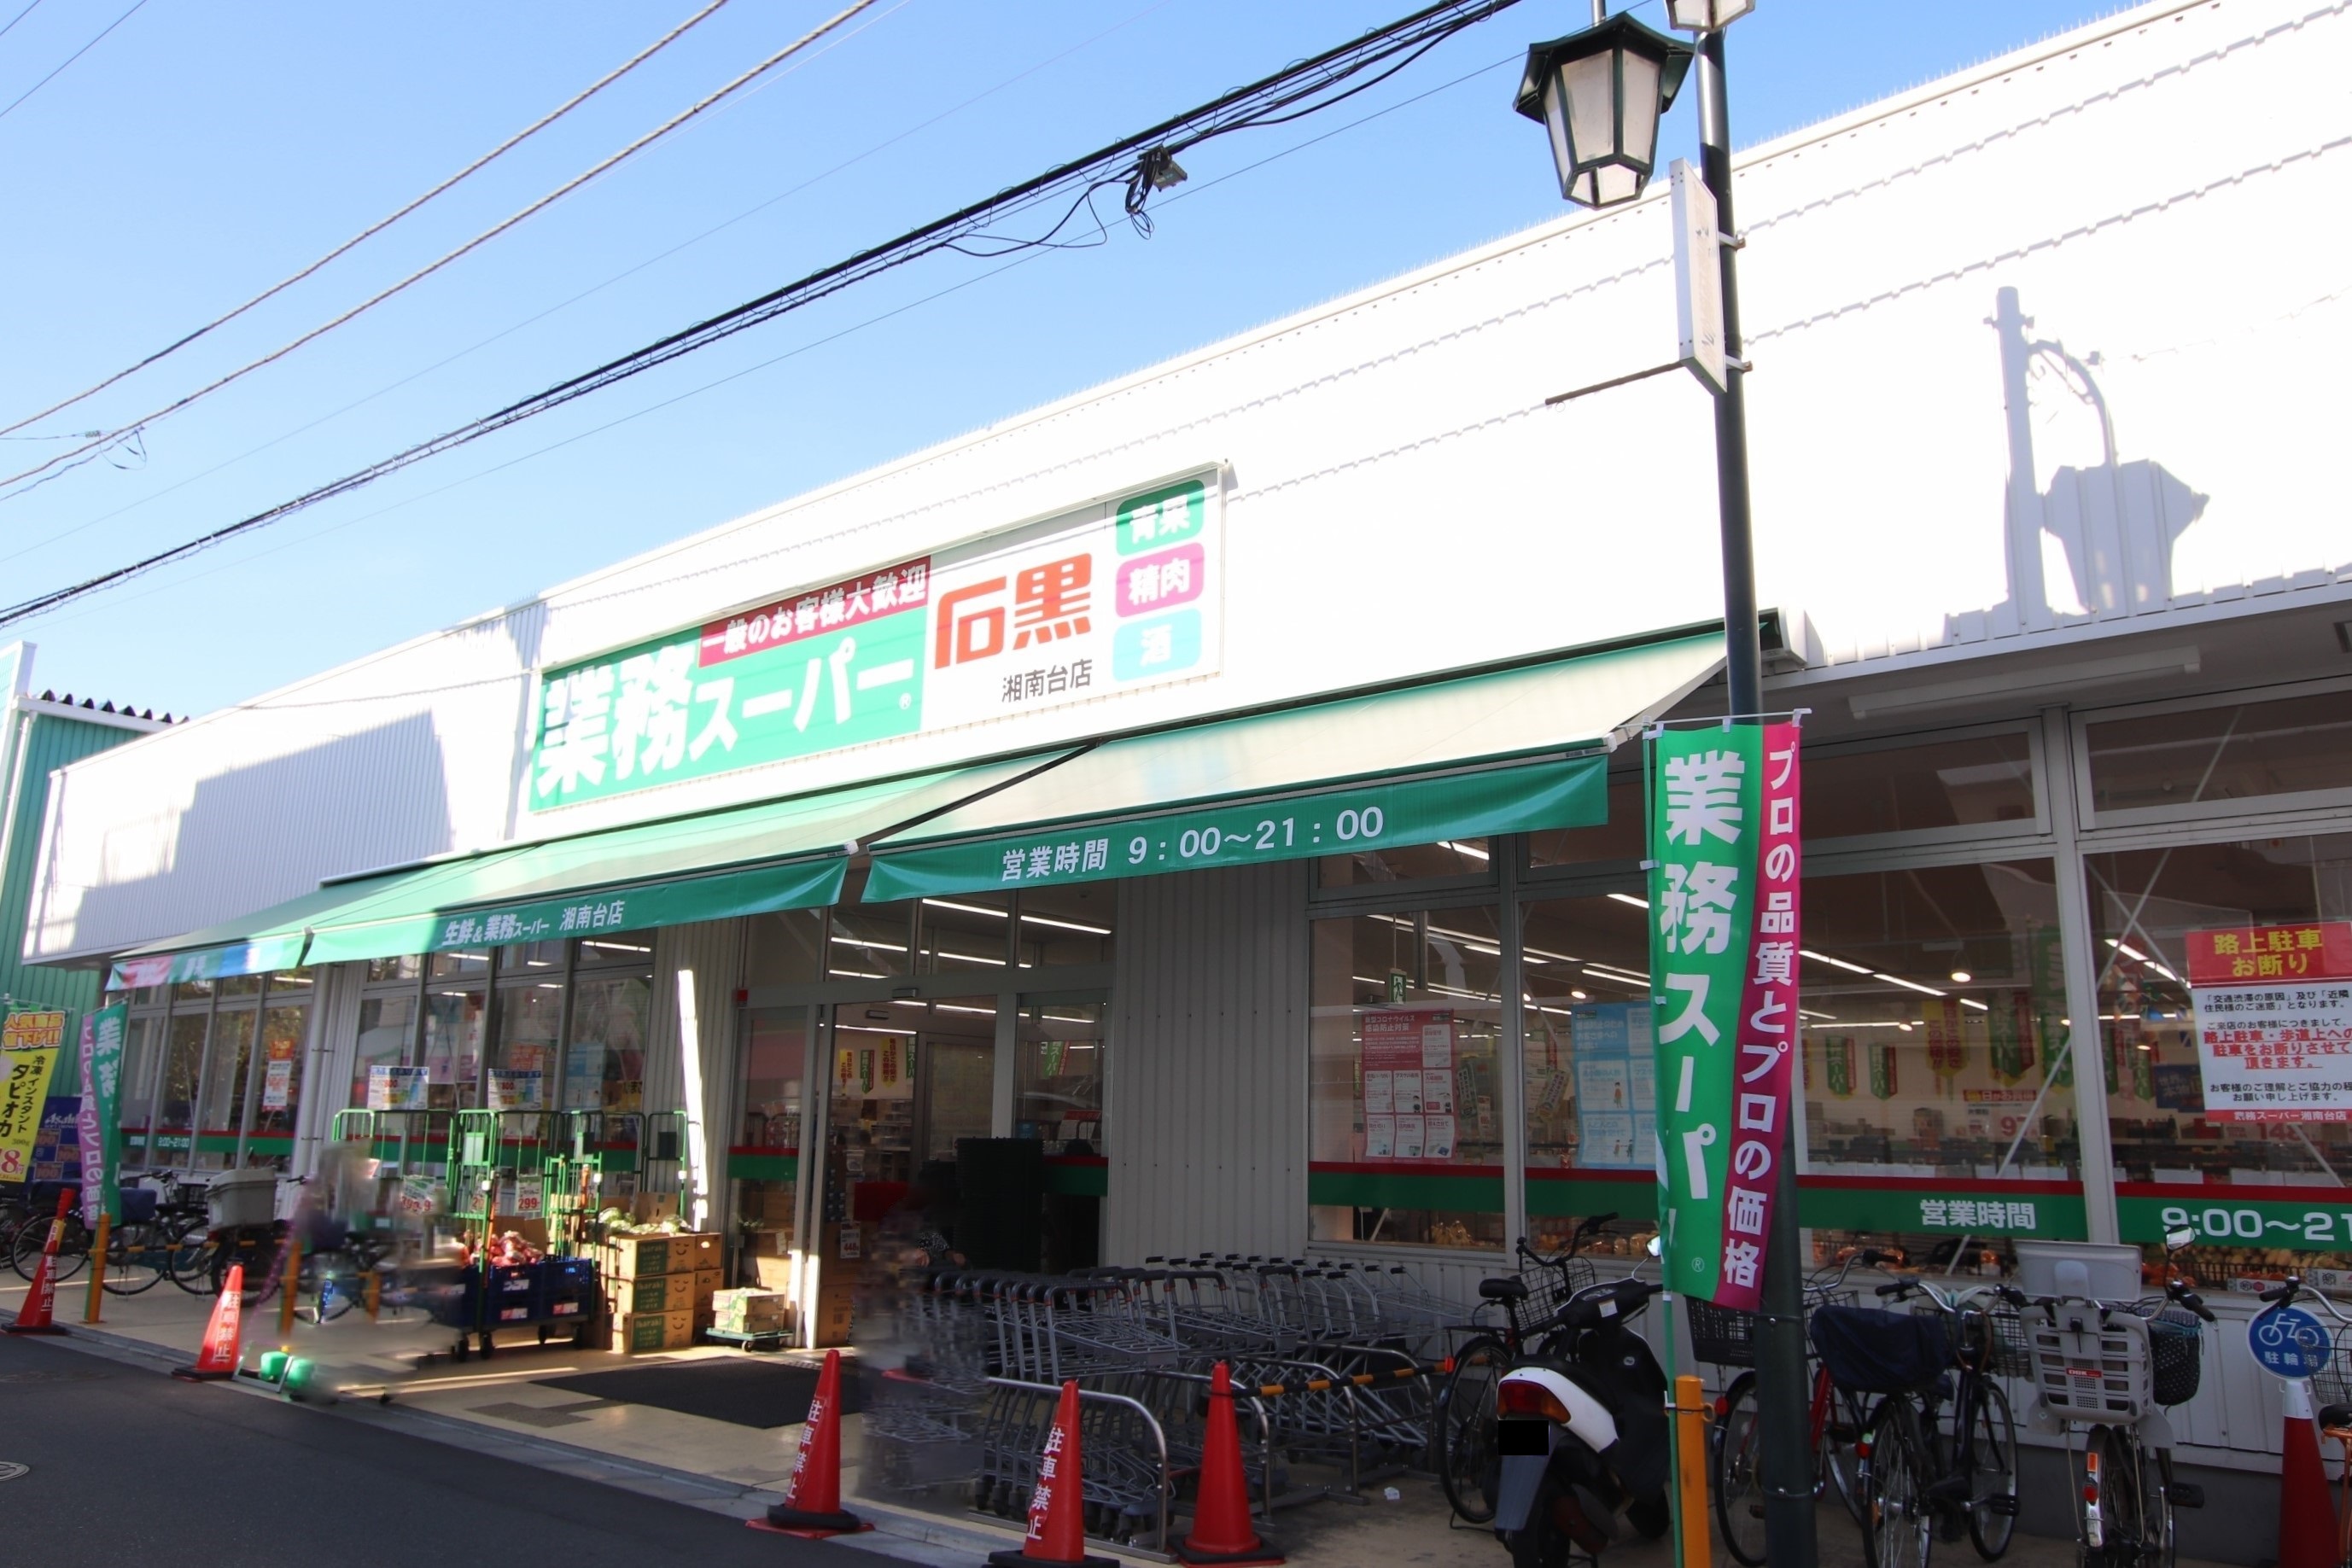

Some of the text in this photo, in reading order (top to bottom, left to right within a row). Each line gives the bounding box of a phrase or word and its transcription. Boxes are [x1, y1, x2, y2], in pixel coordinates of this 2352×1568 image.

[1129, 557, 1190, 605] 精肉
[702, 564, 927, 654] 一般のお客様大歓迎
[935, 552, 1092, 670] 石黒
[1140, 623, 1173, 667] 酒
[1001, 658, 1093, 703] 湘南台店
[537, 636, 914, 798] 業務スーパー
[1001, 837, 1110, 882] 営業時間
[559, 900, 626, 931] 湘南台店
[2214, 928, 2323, 955] 路上駐車
[2232, 953, 2308, 977] お断り
[1723, 743, 1796, 1290] プロの品質とプロの価格
[2213, 1041, 2352, 1057] 駐車をお断りさせて
[2244, 1056, 2314, 1070] 頂きます。
[0, 1064, 31, 1138] タピオカ
[2233, 1093, 2339, 1102] お願い申し上げます。
[1920, 1199, 2036, 1230] 営業時間
[1027, 1426, 1065, 1541] 駐車禁止
